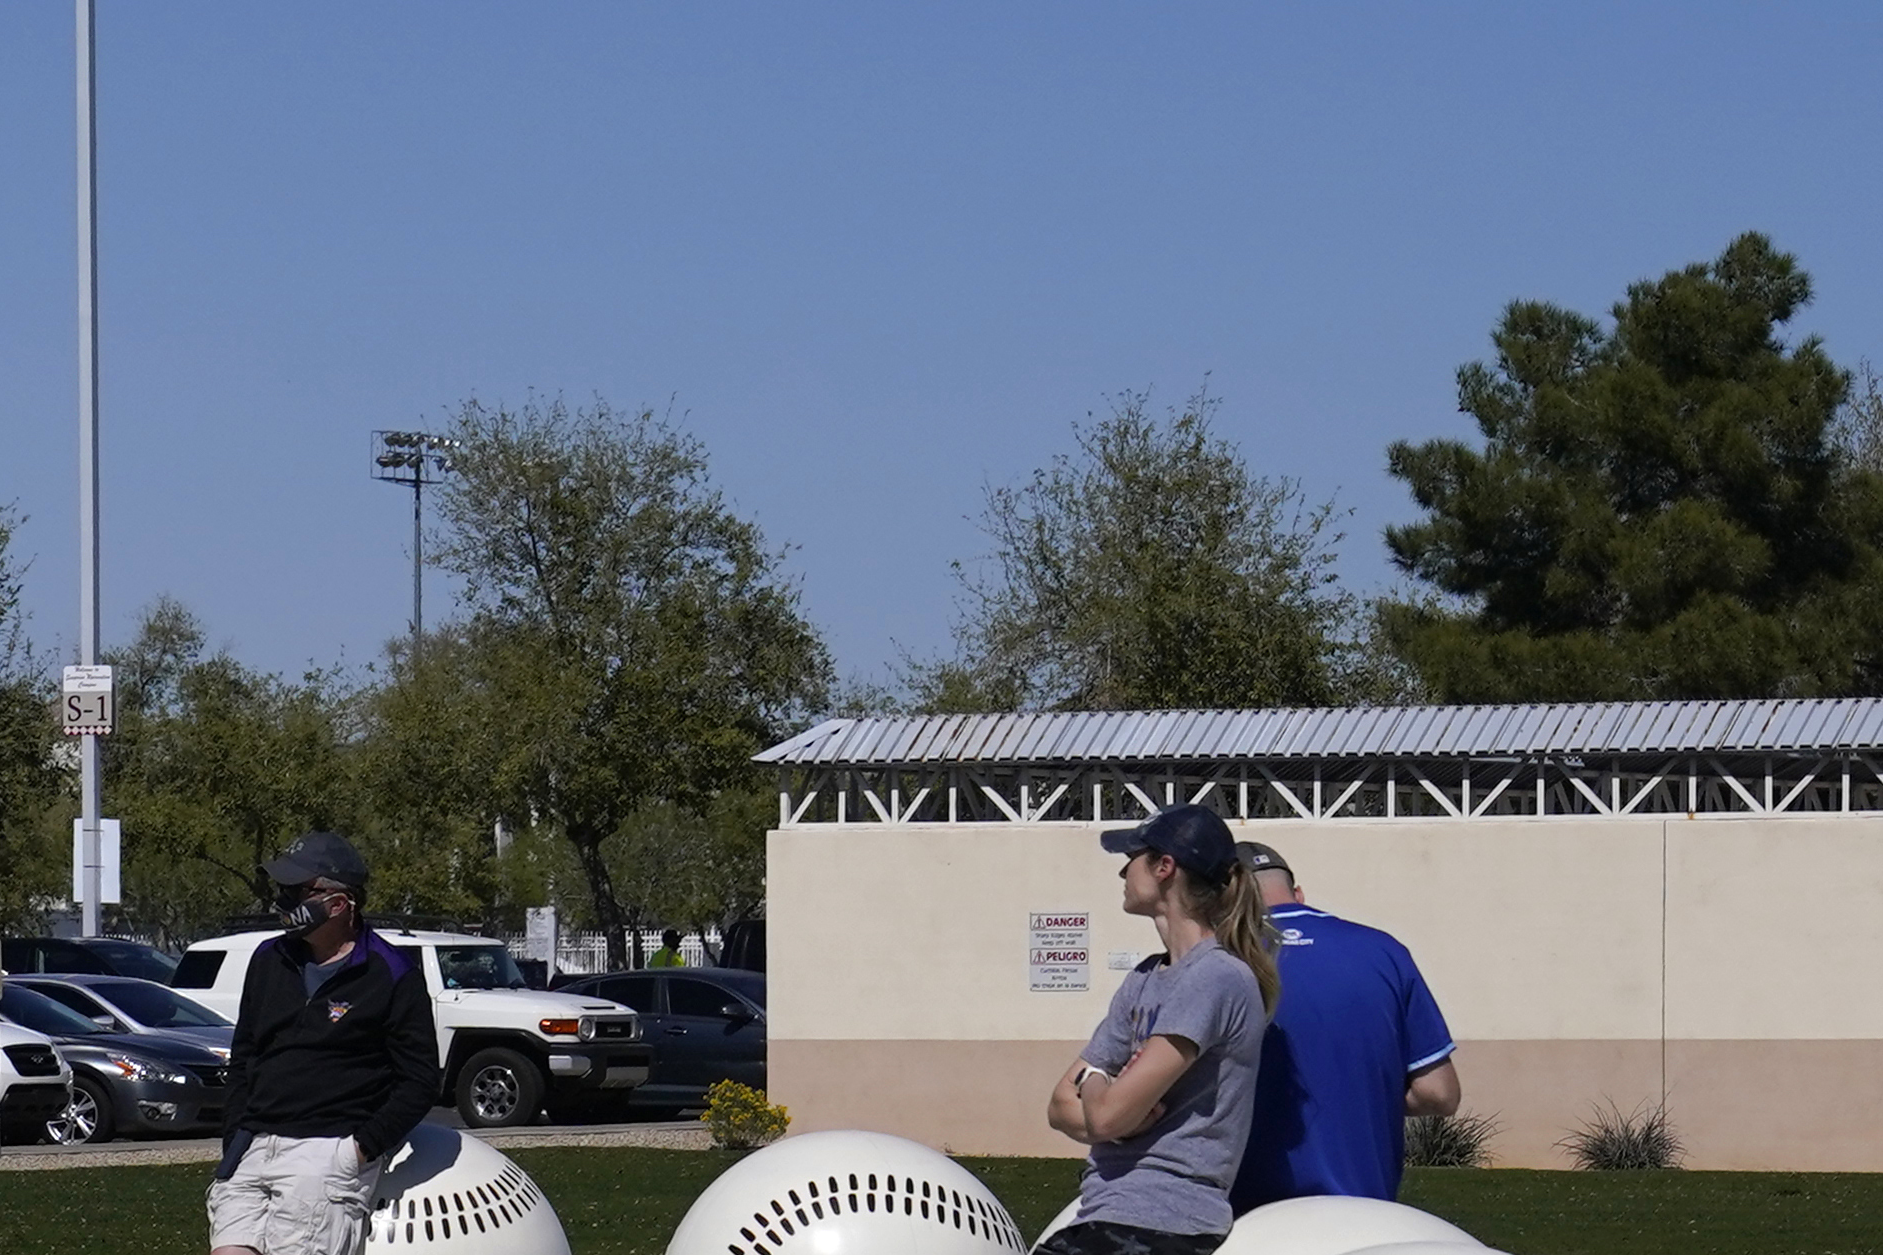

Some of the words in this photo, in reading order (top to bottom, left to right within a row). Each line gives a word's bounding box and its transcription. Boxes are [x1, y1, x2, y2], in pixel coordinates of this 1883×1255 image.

[67, 695, 107, 722] S-1
[1046, 917, 1086, 927] DANGER
[1046, 952, 1086, 961] PELIGRO
